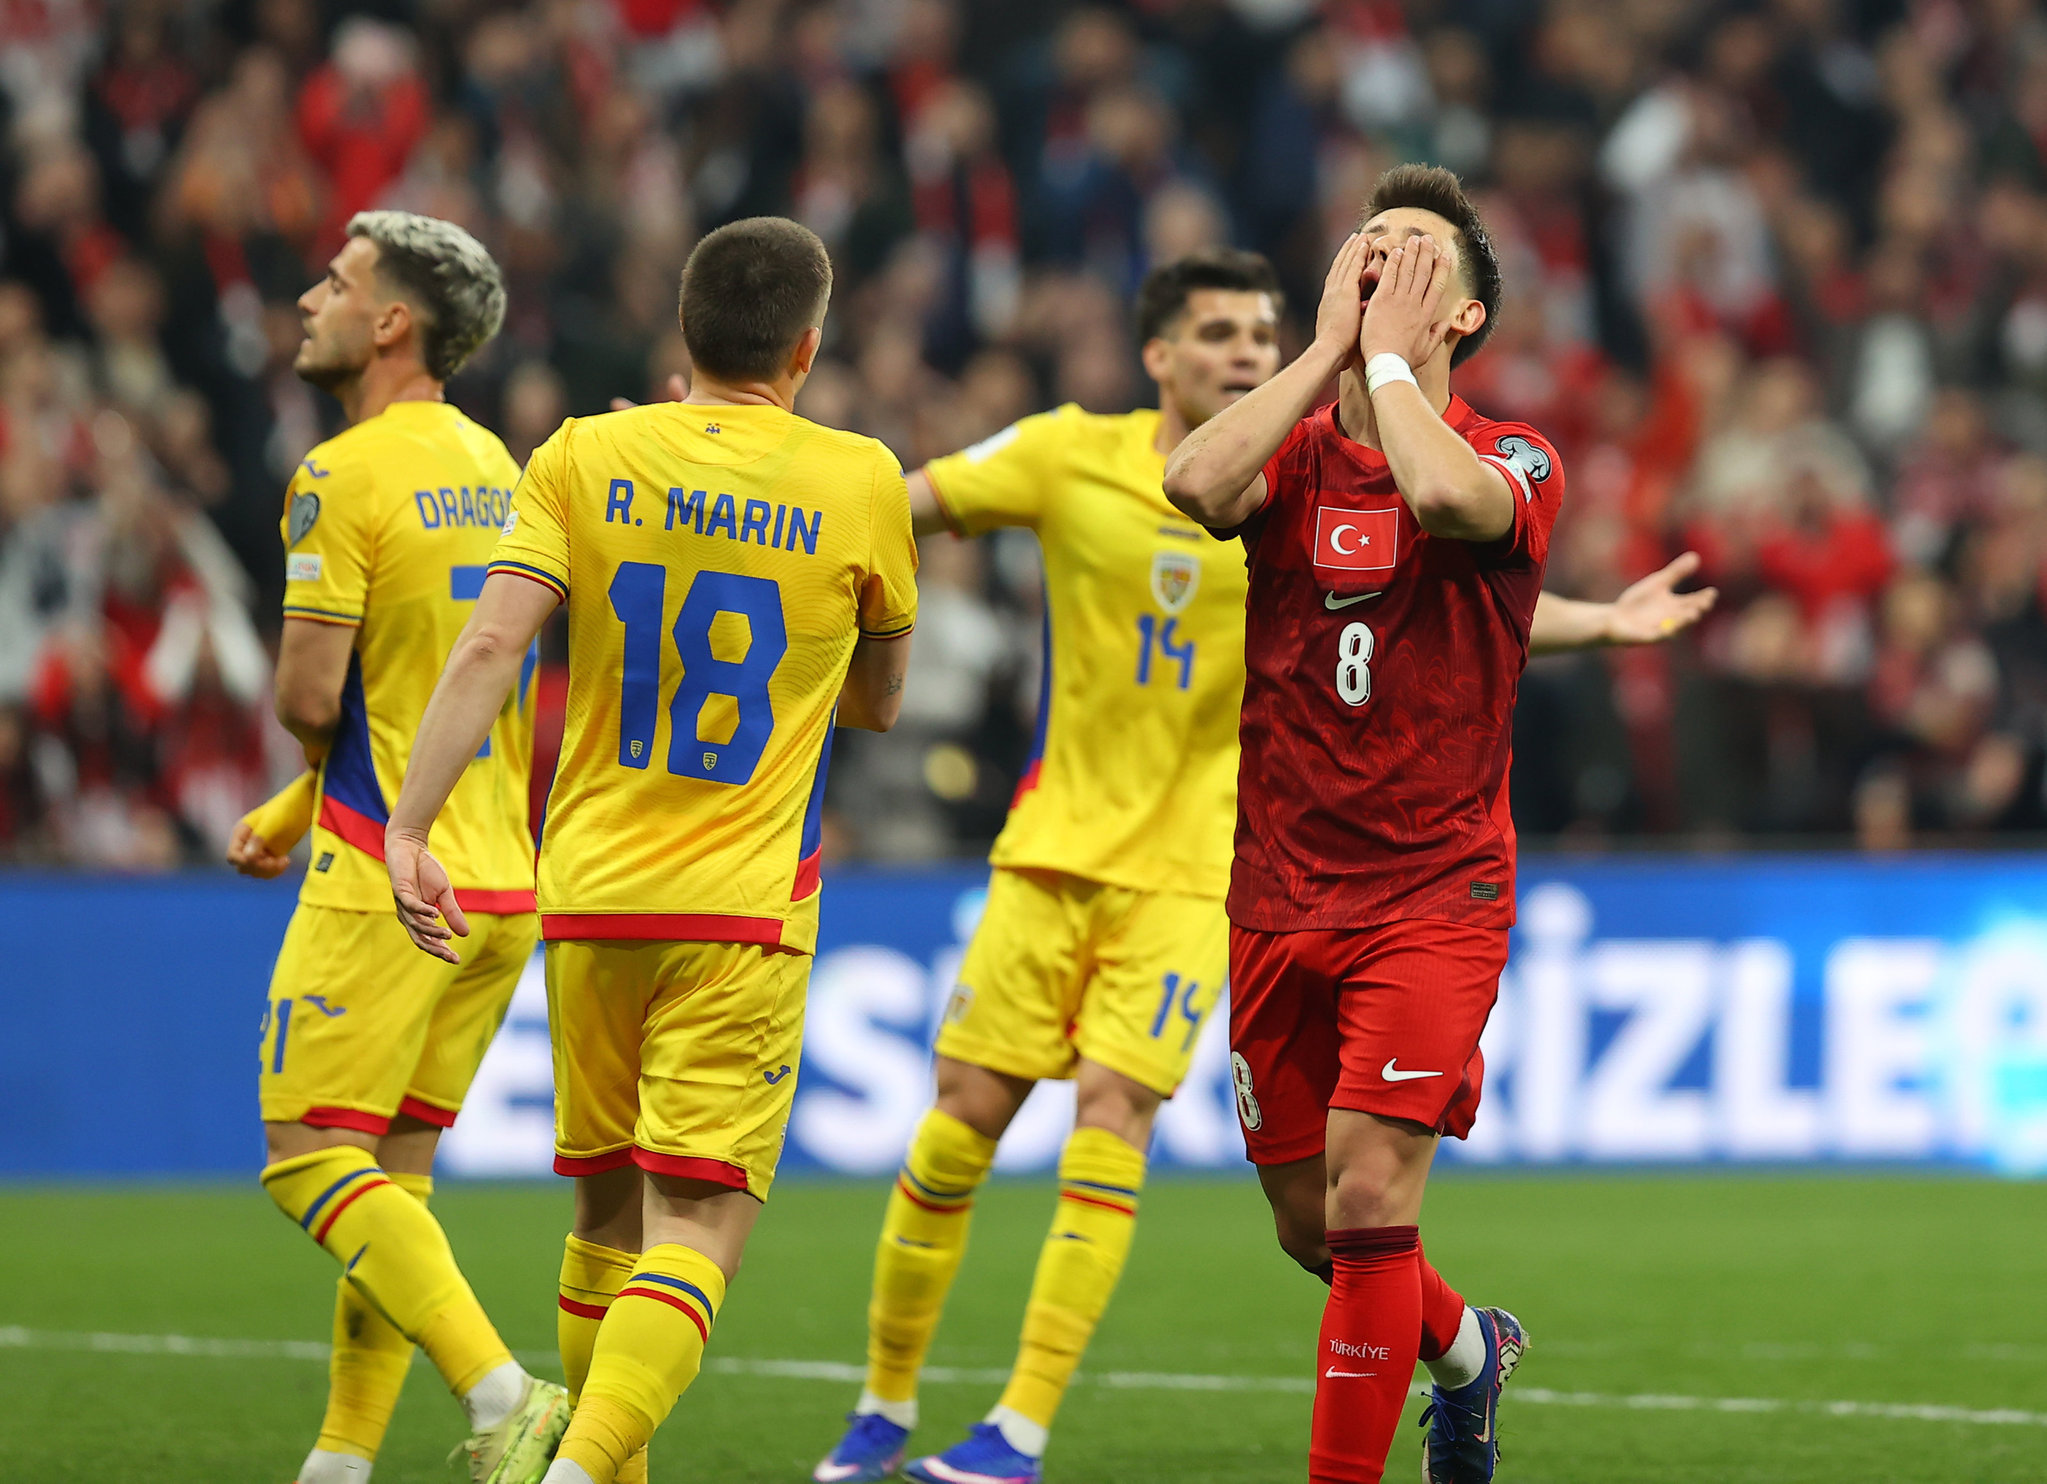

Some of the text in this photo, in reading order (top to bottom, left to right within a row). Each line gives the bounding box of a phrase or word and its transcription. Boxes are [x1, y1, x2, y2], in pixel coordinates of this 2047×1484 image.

[605, 478, 823, 556] R. MARIN
[608, 561, 788, 786] 18
[1135, 613, 1196, 691] 14
[1336, 621, 1375, 707] 8
[1150, 972, 1202, 1054] 14
[1231, 1050, 1263, 1132] 8
[1329, 1338, 1391, 1361] TÜRKİYE
